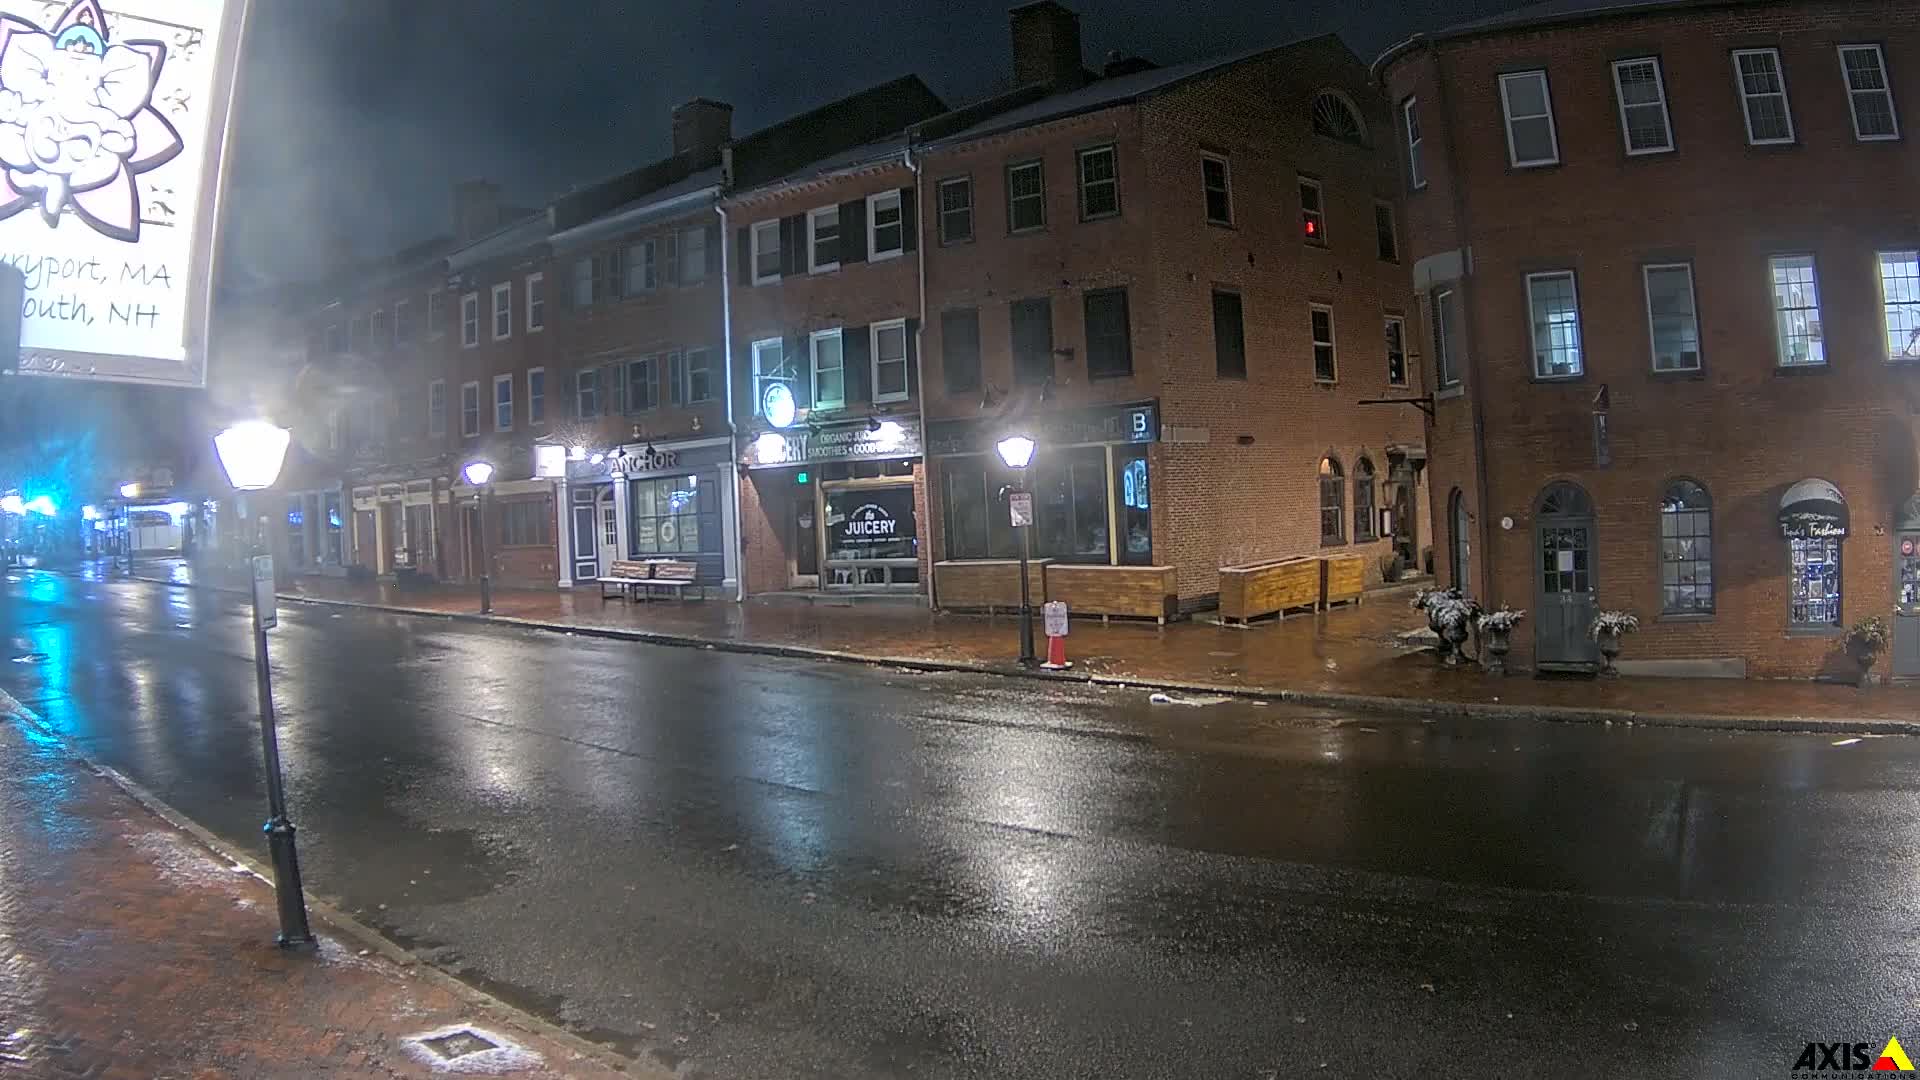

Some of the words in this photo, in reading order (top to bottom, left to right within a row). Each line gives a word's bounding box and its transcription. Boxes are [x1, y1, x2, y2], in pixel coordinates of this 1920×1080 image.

[120, 262, 172, 289] MA
[109, 301, 160, 328] NH
[1133, 413, 1146, 432] B
[821, 431, 852, 444] ORGANIC
[808, 445, 848, 457] SMOOTHIES
[611, 451, 680, 473] ANCHOR
[845, 519, 896, 535] JUICERY
